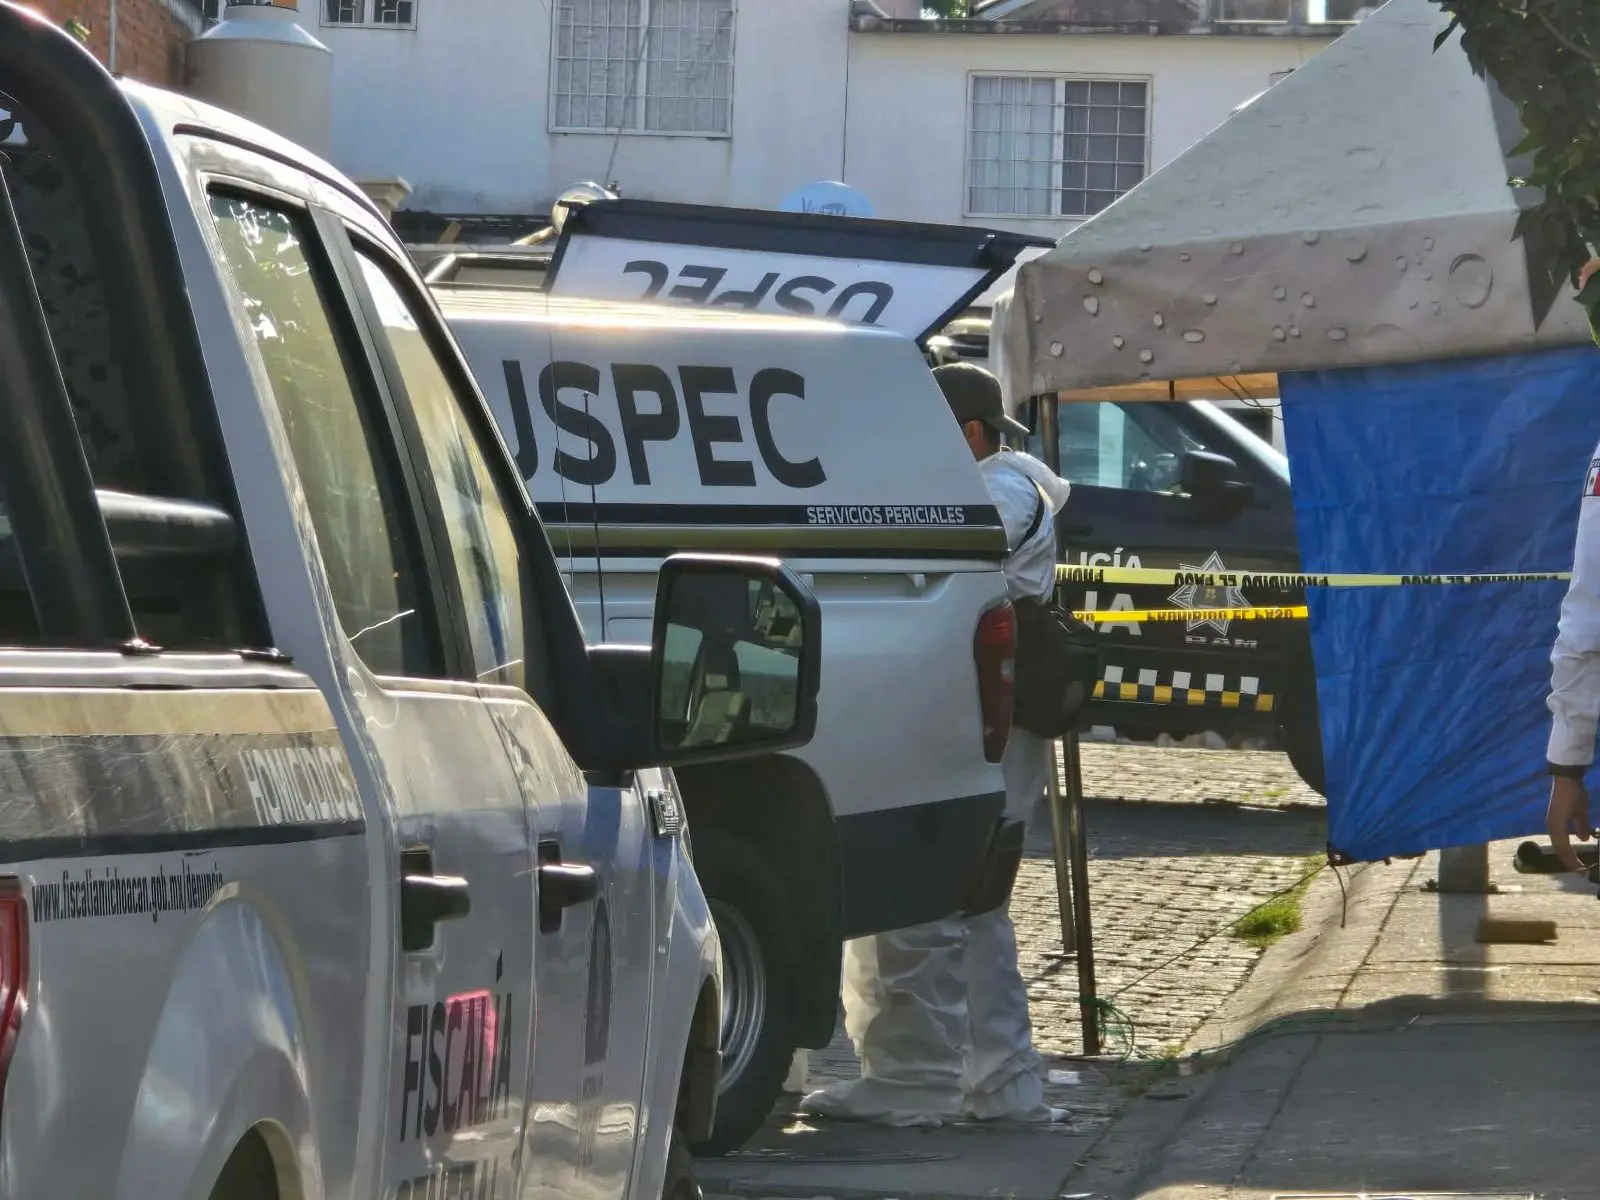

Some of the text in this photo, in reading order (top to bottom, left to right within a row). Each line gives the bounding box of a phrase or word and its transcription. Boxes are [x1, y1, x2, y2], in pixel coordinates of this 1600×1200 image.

[806, 506, 965, 524] SERVICIOS PERICIALES
[399, 948, 513, 1143] FISCALÍA
